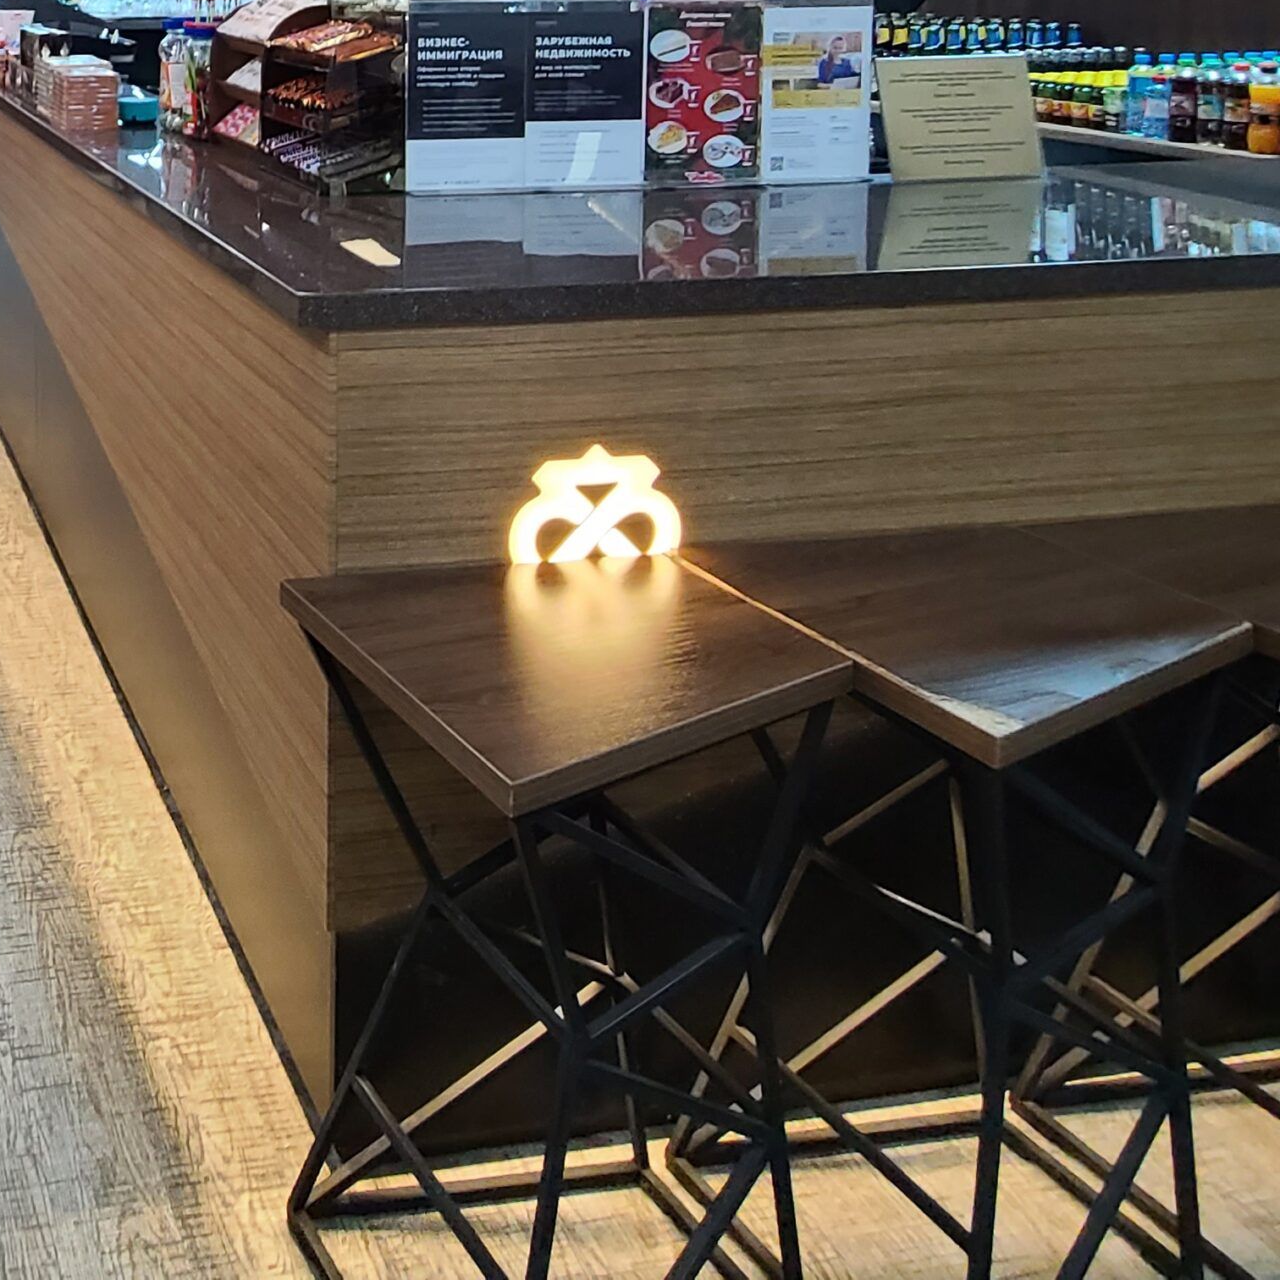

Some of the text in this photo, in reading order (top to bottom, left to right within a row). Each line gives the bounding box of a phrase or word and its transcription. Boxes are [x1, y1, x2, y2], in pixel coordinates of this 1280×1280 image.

[417, 37, 470, 48] БИЗНЕС-
[535, 36, 613, 46] ЗАРУБЕЖНАЯ
[417, 50, 503, 62] ИММИГРАЦИЯ
[535, 48, 631, 60] НЕДВИЖИМОСТЬ
